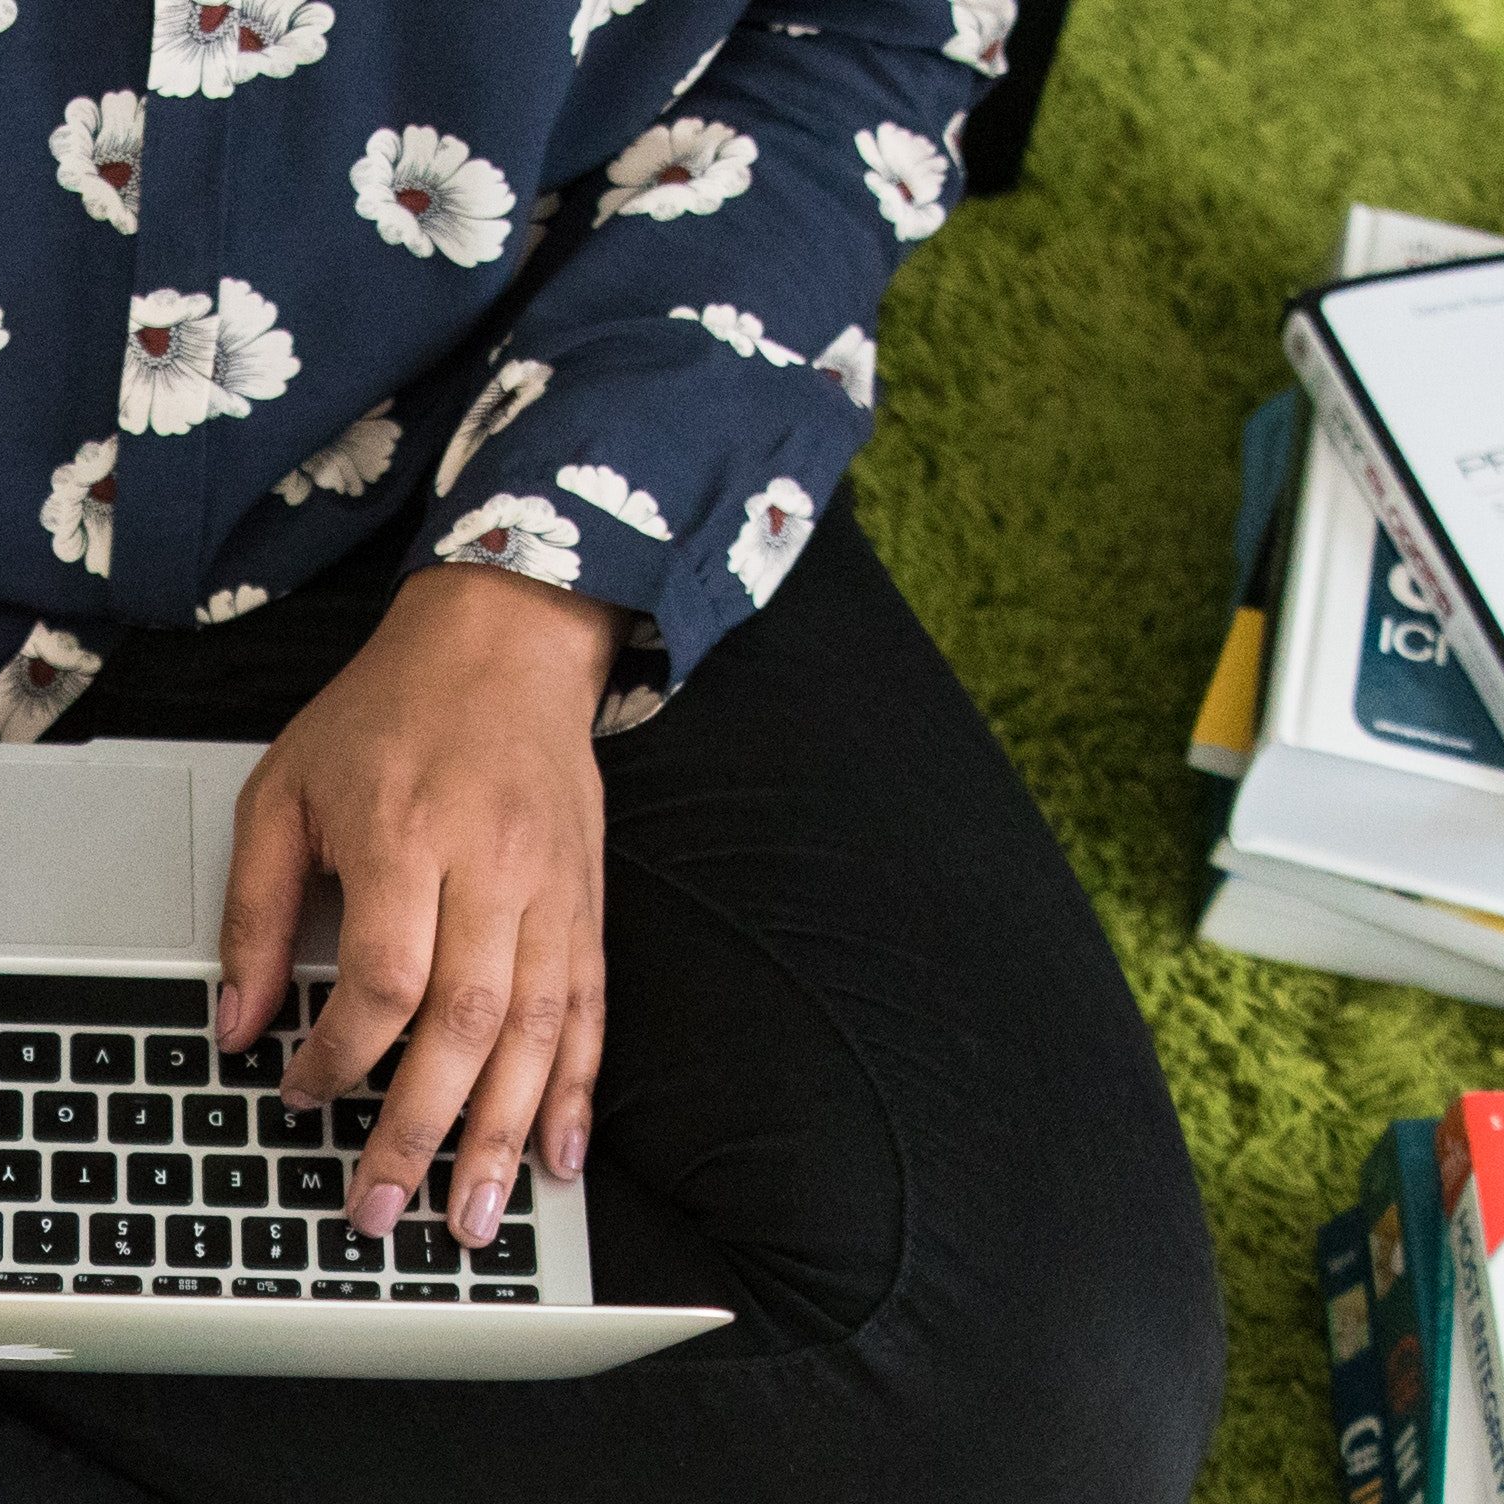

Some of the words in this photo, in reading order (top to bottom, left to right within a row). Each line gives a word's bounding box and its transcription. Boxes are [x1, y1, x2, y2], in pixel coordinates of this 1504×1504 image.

[21, 1045, 34, 1062] B
[94, 1047, 110, 1064] V
[169, 1049, 185, 1066] C
[56, 1105, 74, 1123] G
[134, 1108, 146, 1125] F
[207, 1109, 223, 1127] D
[495, 1287, 515, 1297] esc
